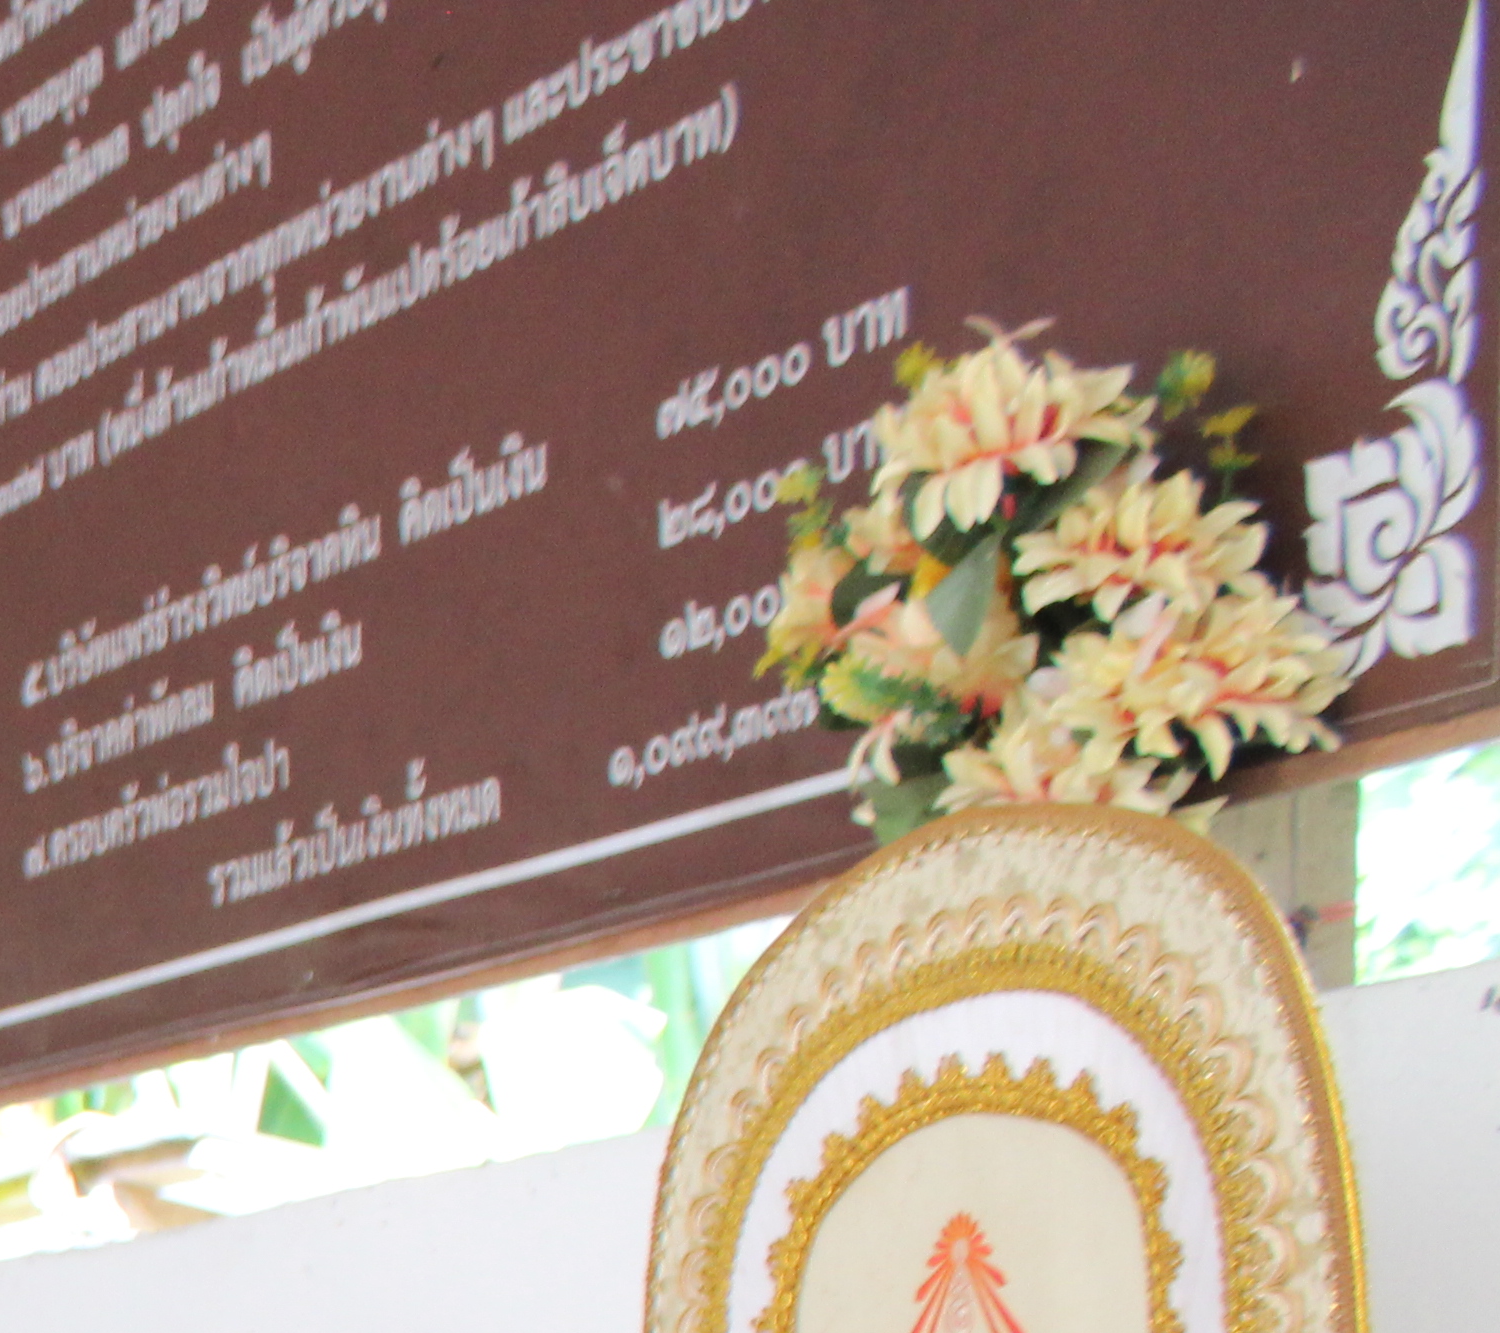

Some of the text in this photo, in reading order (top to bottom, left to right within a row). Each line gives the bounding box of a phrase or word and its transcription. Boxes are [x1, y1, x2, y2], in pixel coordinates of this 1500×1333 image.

[48, 431, 92, 487] บาท
[400, 432, 545, 543] คิดเป็นเงิน
[658, 343, 809, 437] ๗๕,๐๐๐
[823, 287, 907, 365] บาท
[235, 611, 360, 706] คิดเป็นเงิน
[821, 409, 877, 482] บา
[209, 759, 499, 904] รวมแล้วเป็นเงินทั้งหมด
